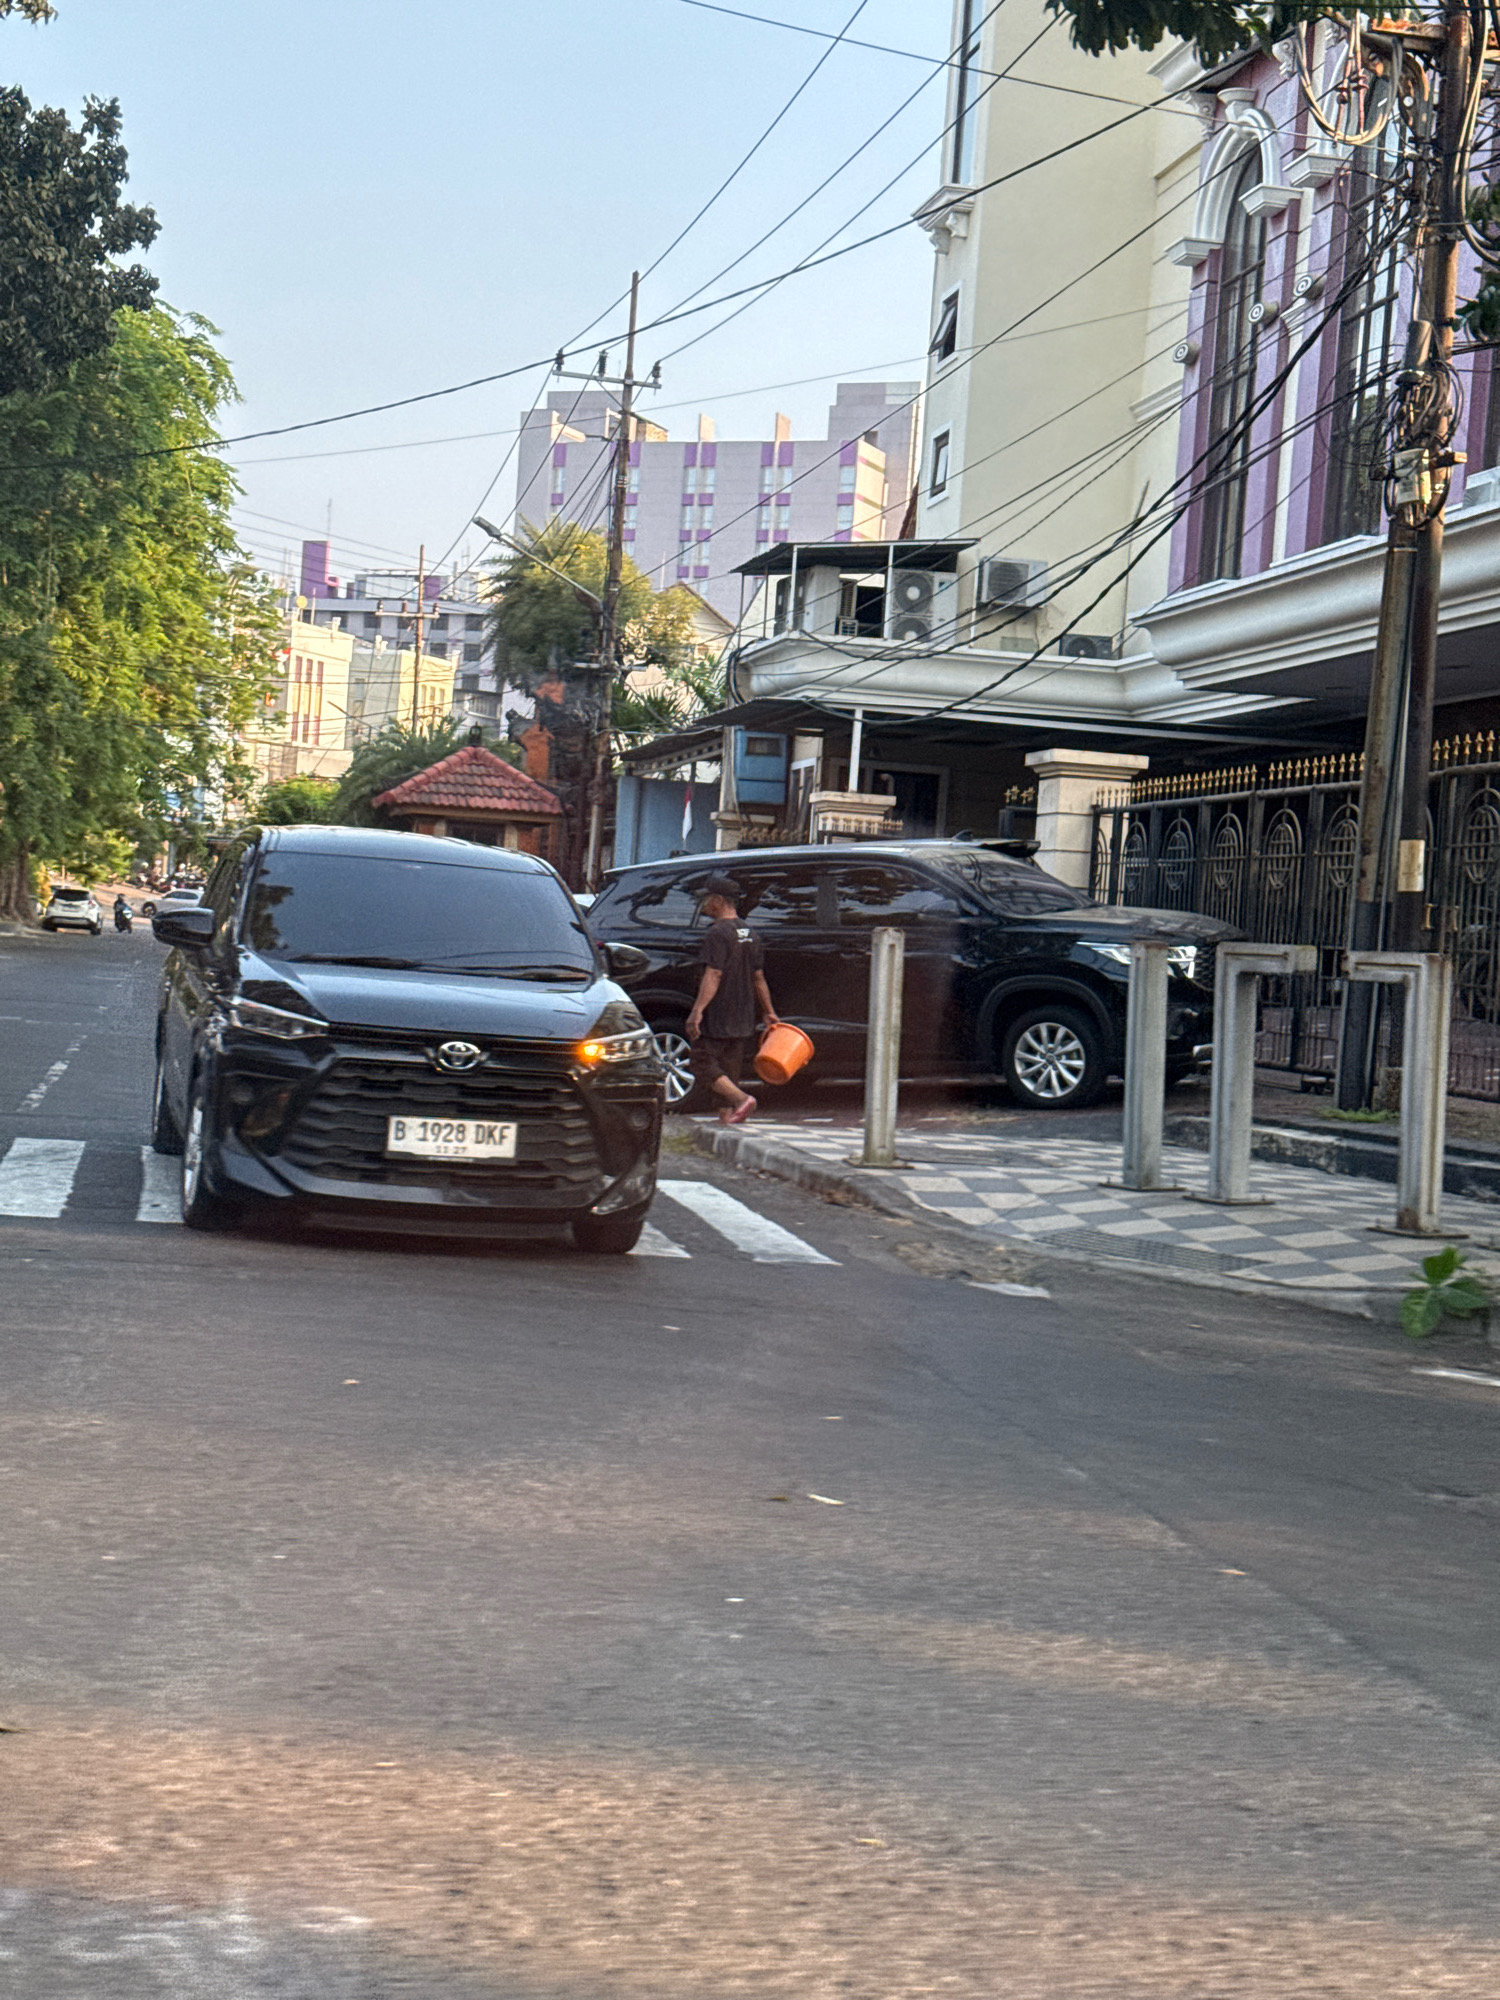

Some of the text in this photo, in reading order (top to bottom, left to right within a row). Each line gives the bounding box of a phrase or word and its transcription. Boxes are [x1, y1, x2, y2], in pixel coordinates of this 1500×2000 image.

[394, 1120, 510, 1146] B 1928 DKF
